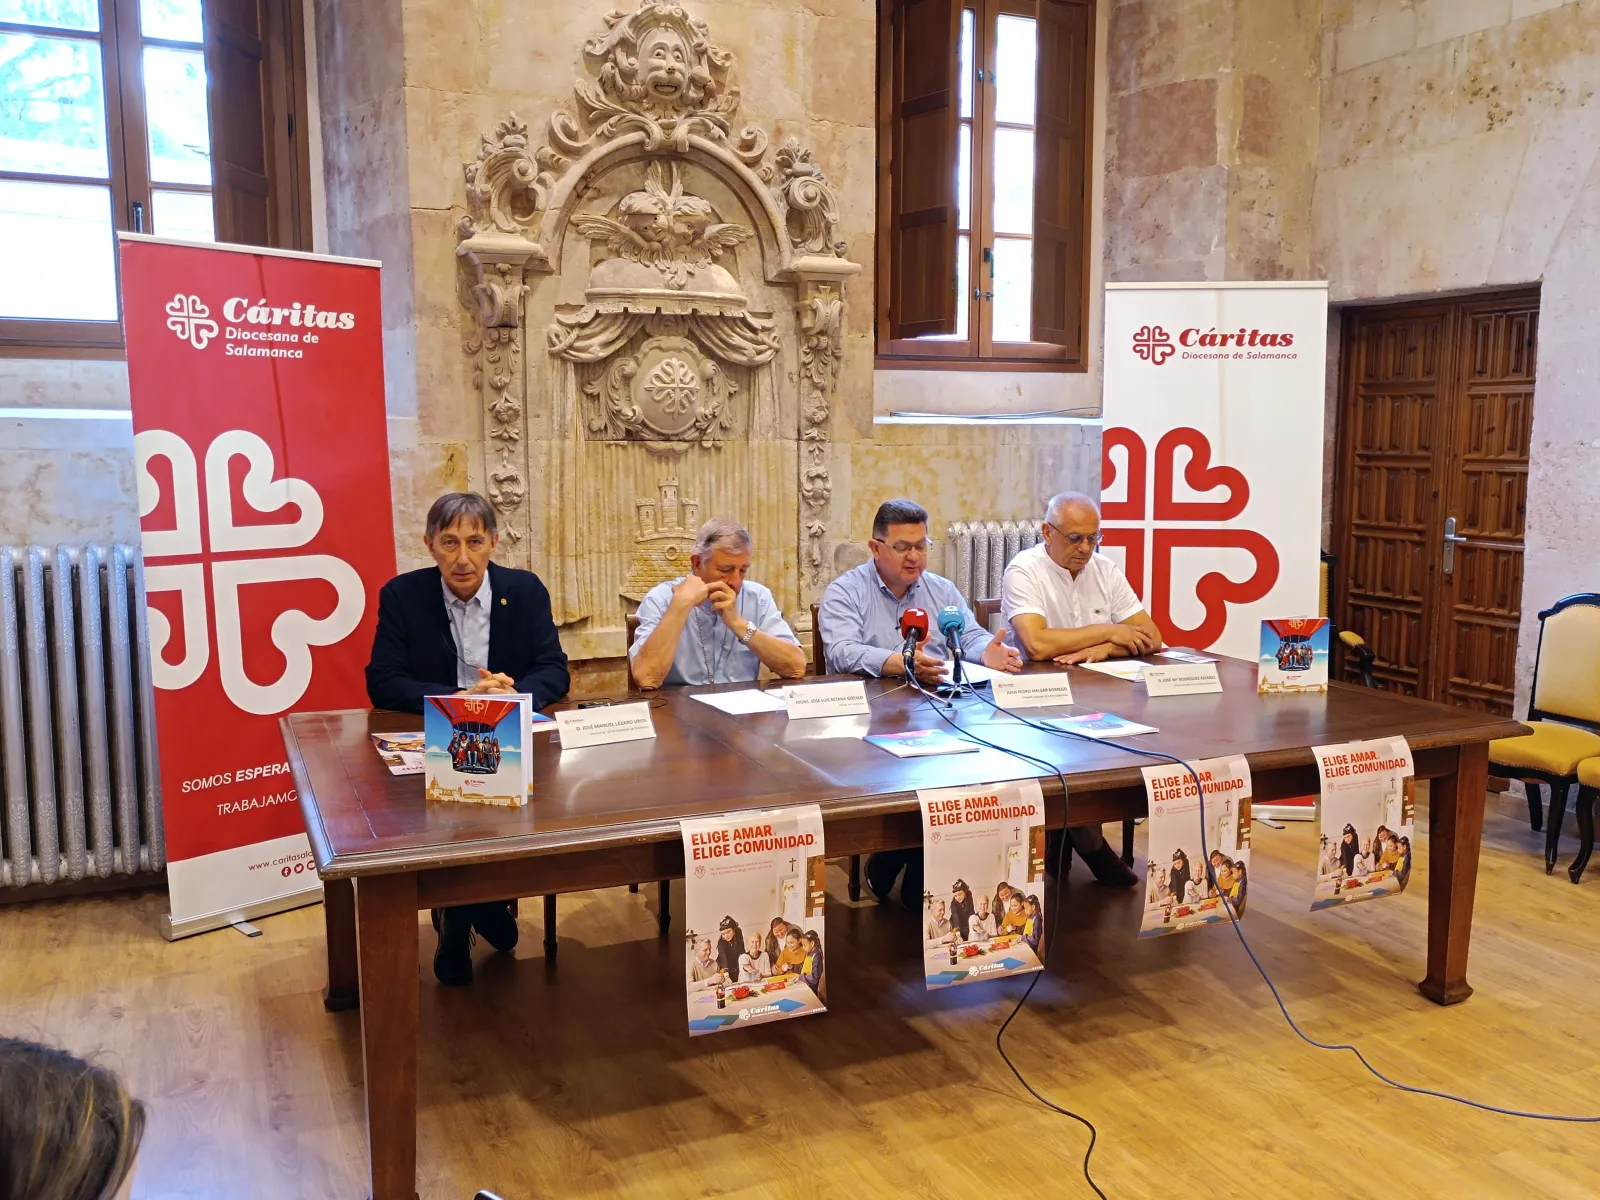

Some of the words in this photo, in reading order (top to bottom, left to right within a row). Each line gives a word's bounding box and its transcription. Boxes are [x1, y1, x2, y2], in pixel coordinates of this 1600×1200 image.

[223, 297, 354, 330] Cáritas
[226, 327, 298, 343] Diocesana
[302, 331, 318, 344] de
[1179, 328, 1294, 347] Cáritas
[225, 344, 303, 359] Salamanca
[1182, 352, 1229, 360] Diocesana
[1232, 352, 1244, 360] de
[1246, 352, 1298, 360] Salamanca
[1322, 754, 1348, 767] ELIGE
[1325, 766, 1350, 778] ELIGE
[182, 772, 232, 793] SOMOS
[1152, 776, 1180, 790] ELIGE
[1154, 788, 1182, 802] ELIGE
[928, 800, 961, 814] ELIGE
[930, 813, 962, 827] ELIGE
[692, 830, 729, 846] ELIGE
[693, 844, 730, 861] ELIGE
[750, 1005, 780, 1014] Cáritas
